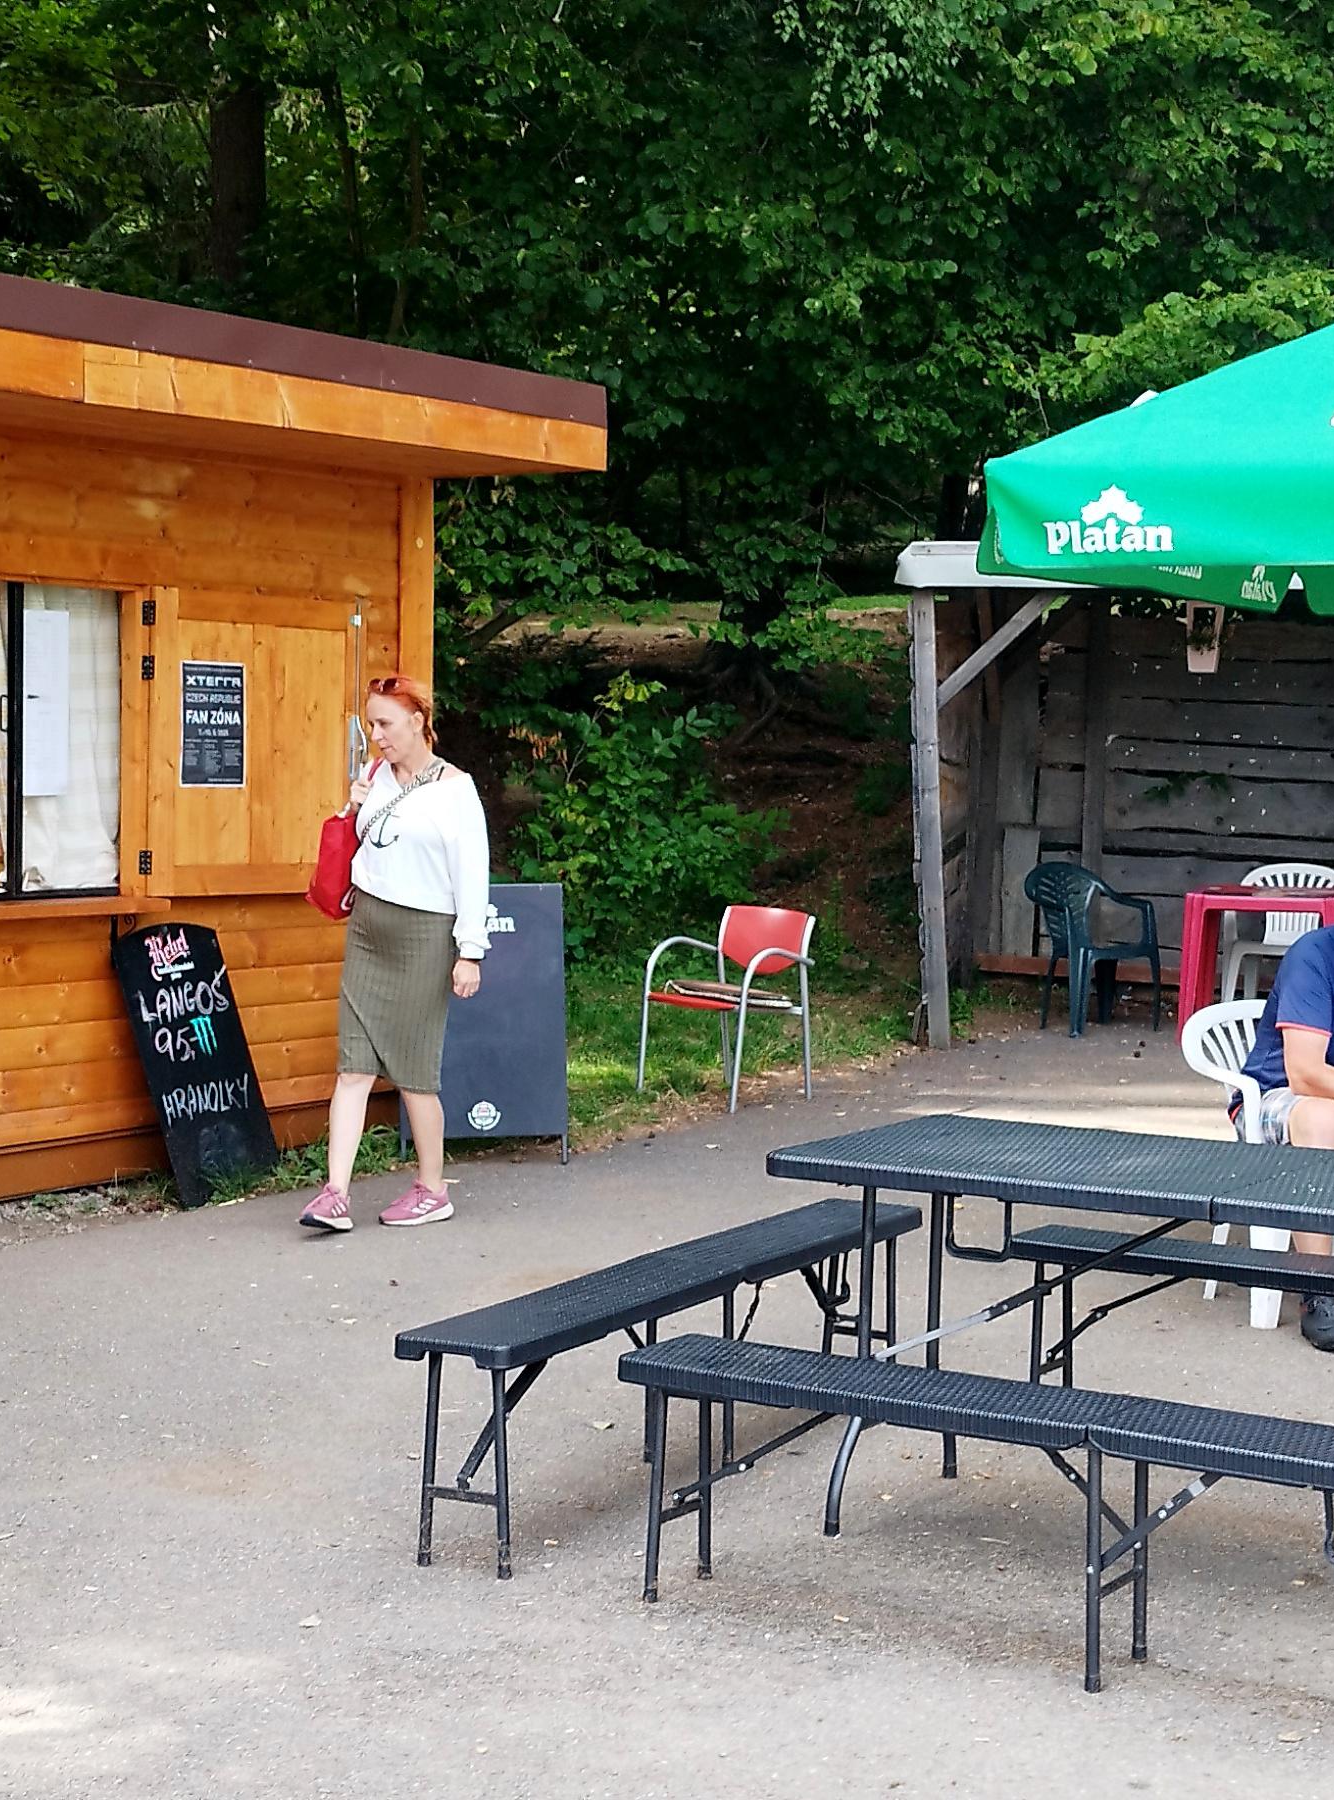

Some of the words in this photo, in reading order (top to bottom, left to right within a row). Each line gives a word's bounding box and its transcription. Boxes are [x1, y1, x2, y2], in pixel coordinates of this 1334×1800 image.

[1043, 517, 1174, 555] Platan
[185, 709, 208, 725] FAN
[209, 706, 241, 725] ZÓNA
[161, 1072, 249, 1129] HRANOLKY
